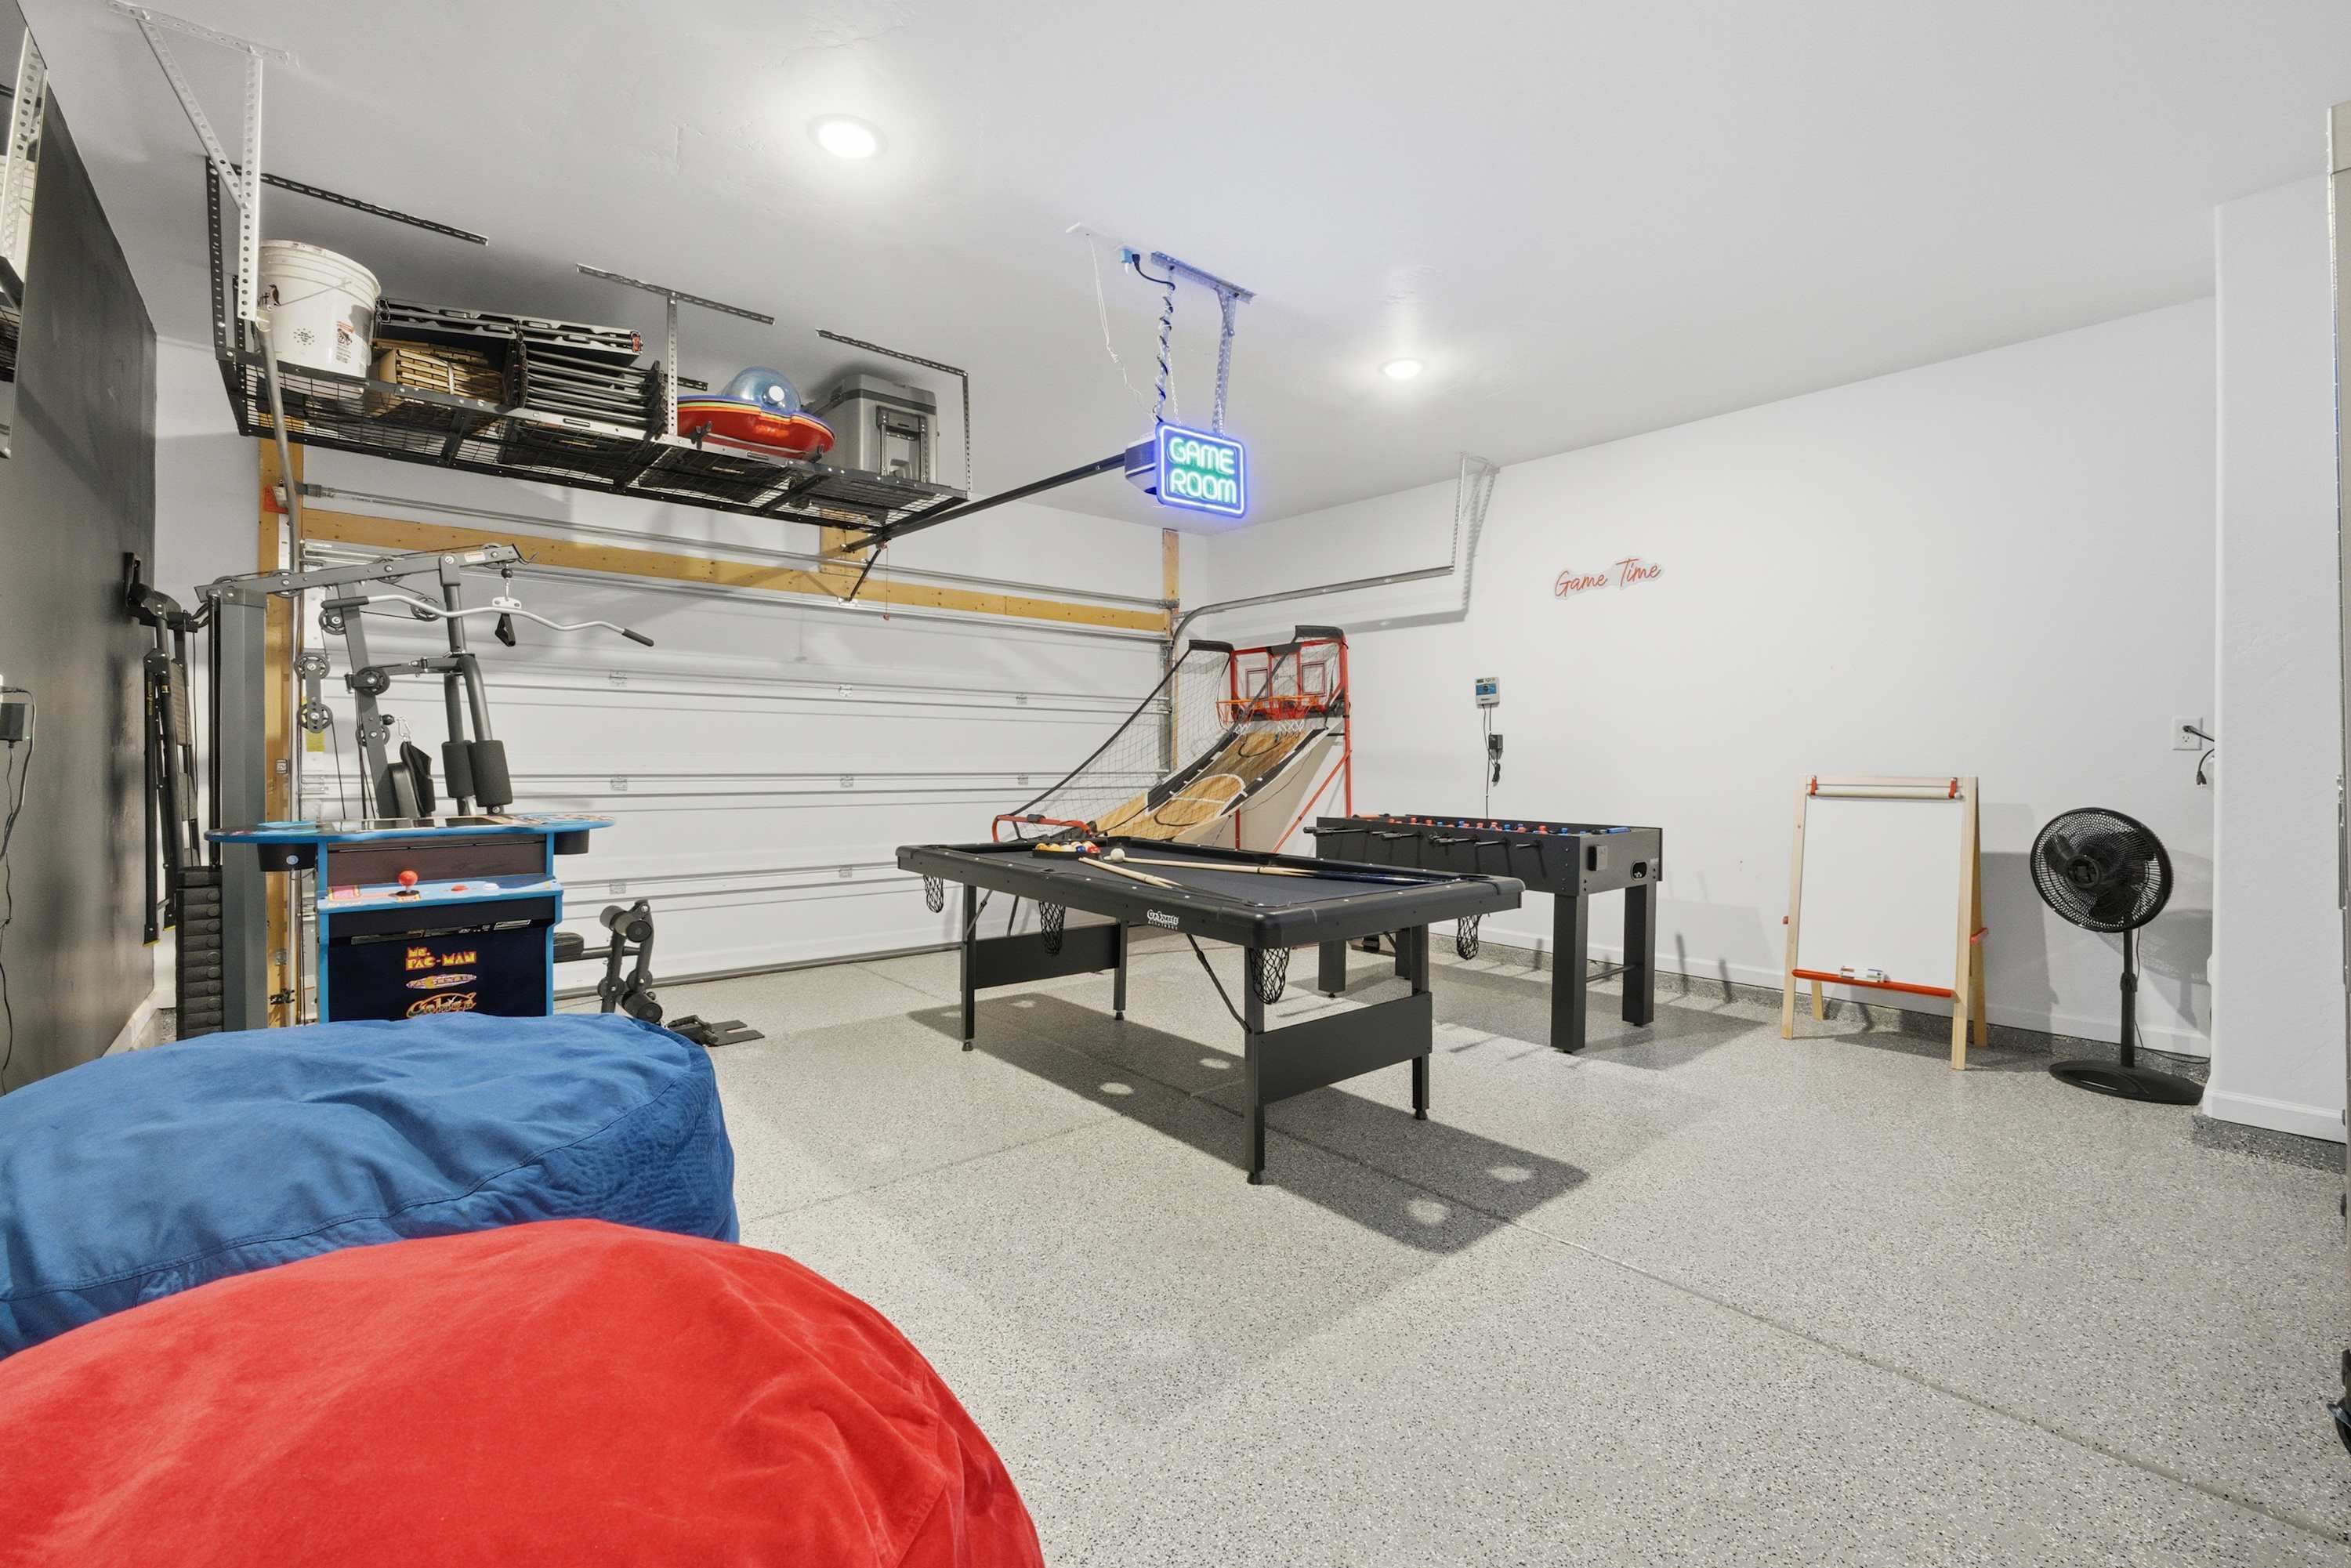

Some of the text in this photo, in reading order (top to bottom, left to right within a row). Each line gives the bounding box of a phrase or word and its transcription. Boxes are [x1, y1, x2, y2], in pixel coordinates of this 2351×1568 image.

[1168, 436, 1236, 475] GAME
[1169, 468, 1237, 504] ROOM
[1554, 558, 1662, 598] Game Time
[405, 951, 476, 971] PAC-MAN
